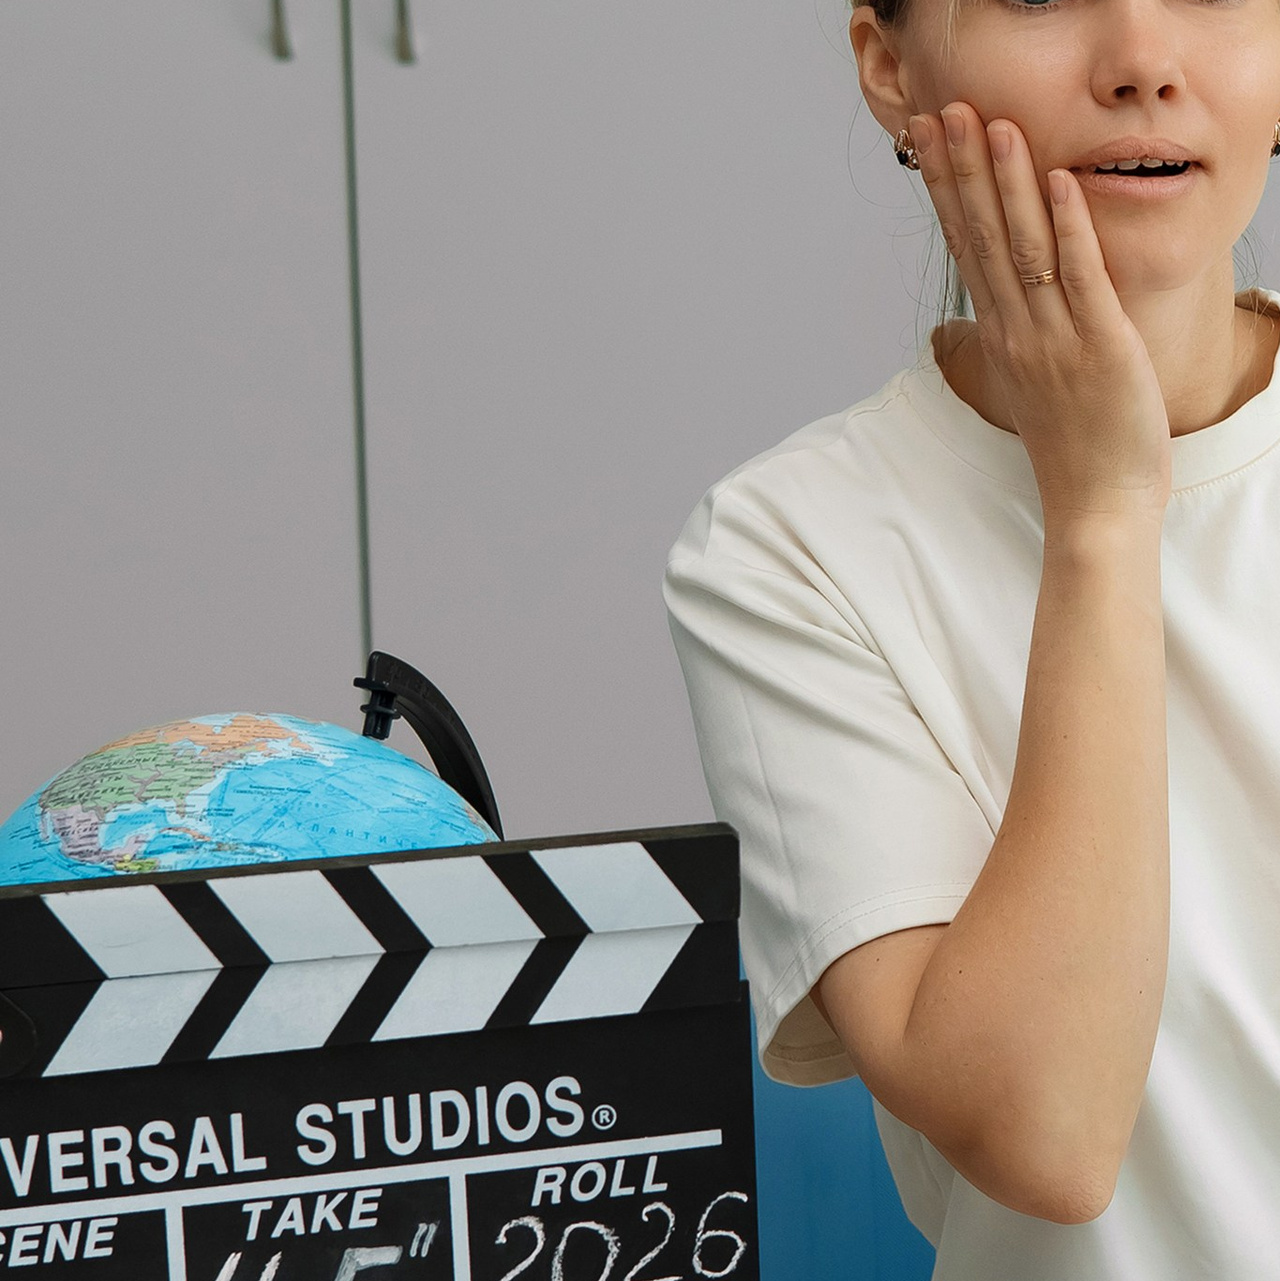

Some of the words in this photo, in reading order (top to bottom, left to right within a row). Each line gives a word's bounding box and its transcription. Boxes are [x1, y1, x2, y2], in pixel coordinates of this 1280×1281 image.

[530, 1155, 669, 1207] ROLL
[242, 1188, 383, 1242] TAKE
[0, 1216, 119, 1268] ENE
